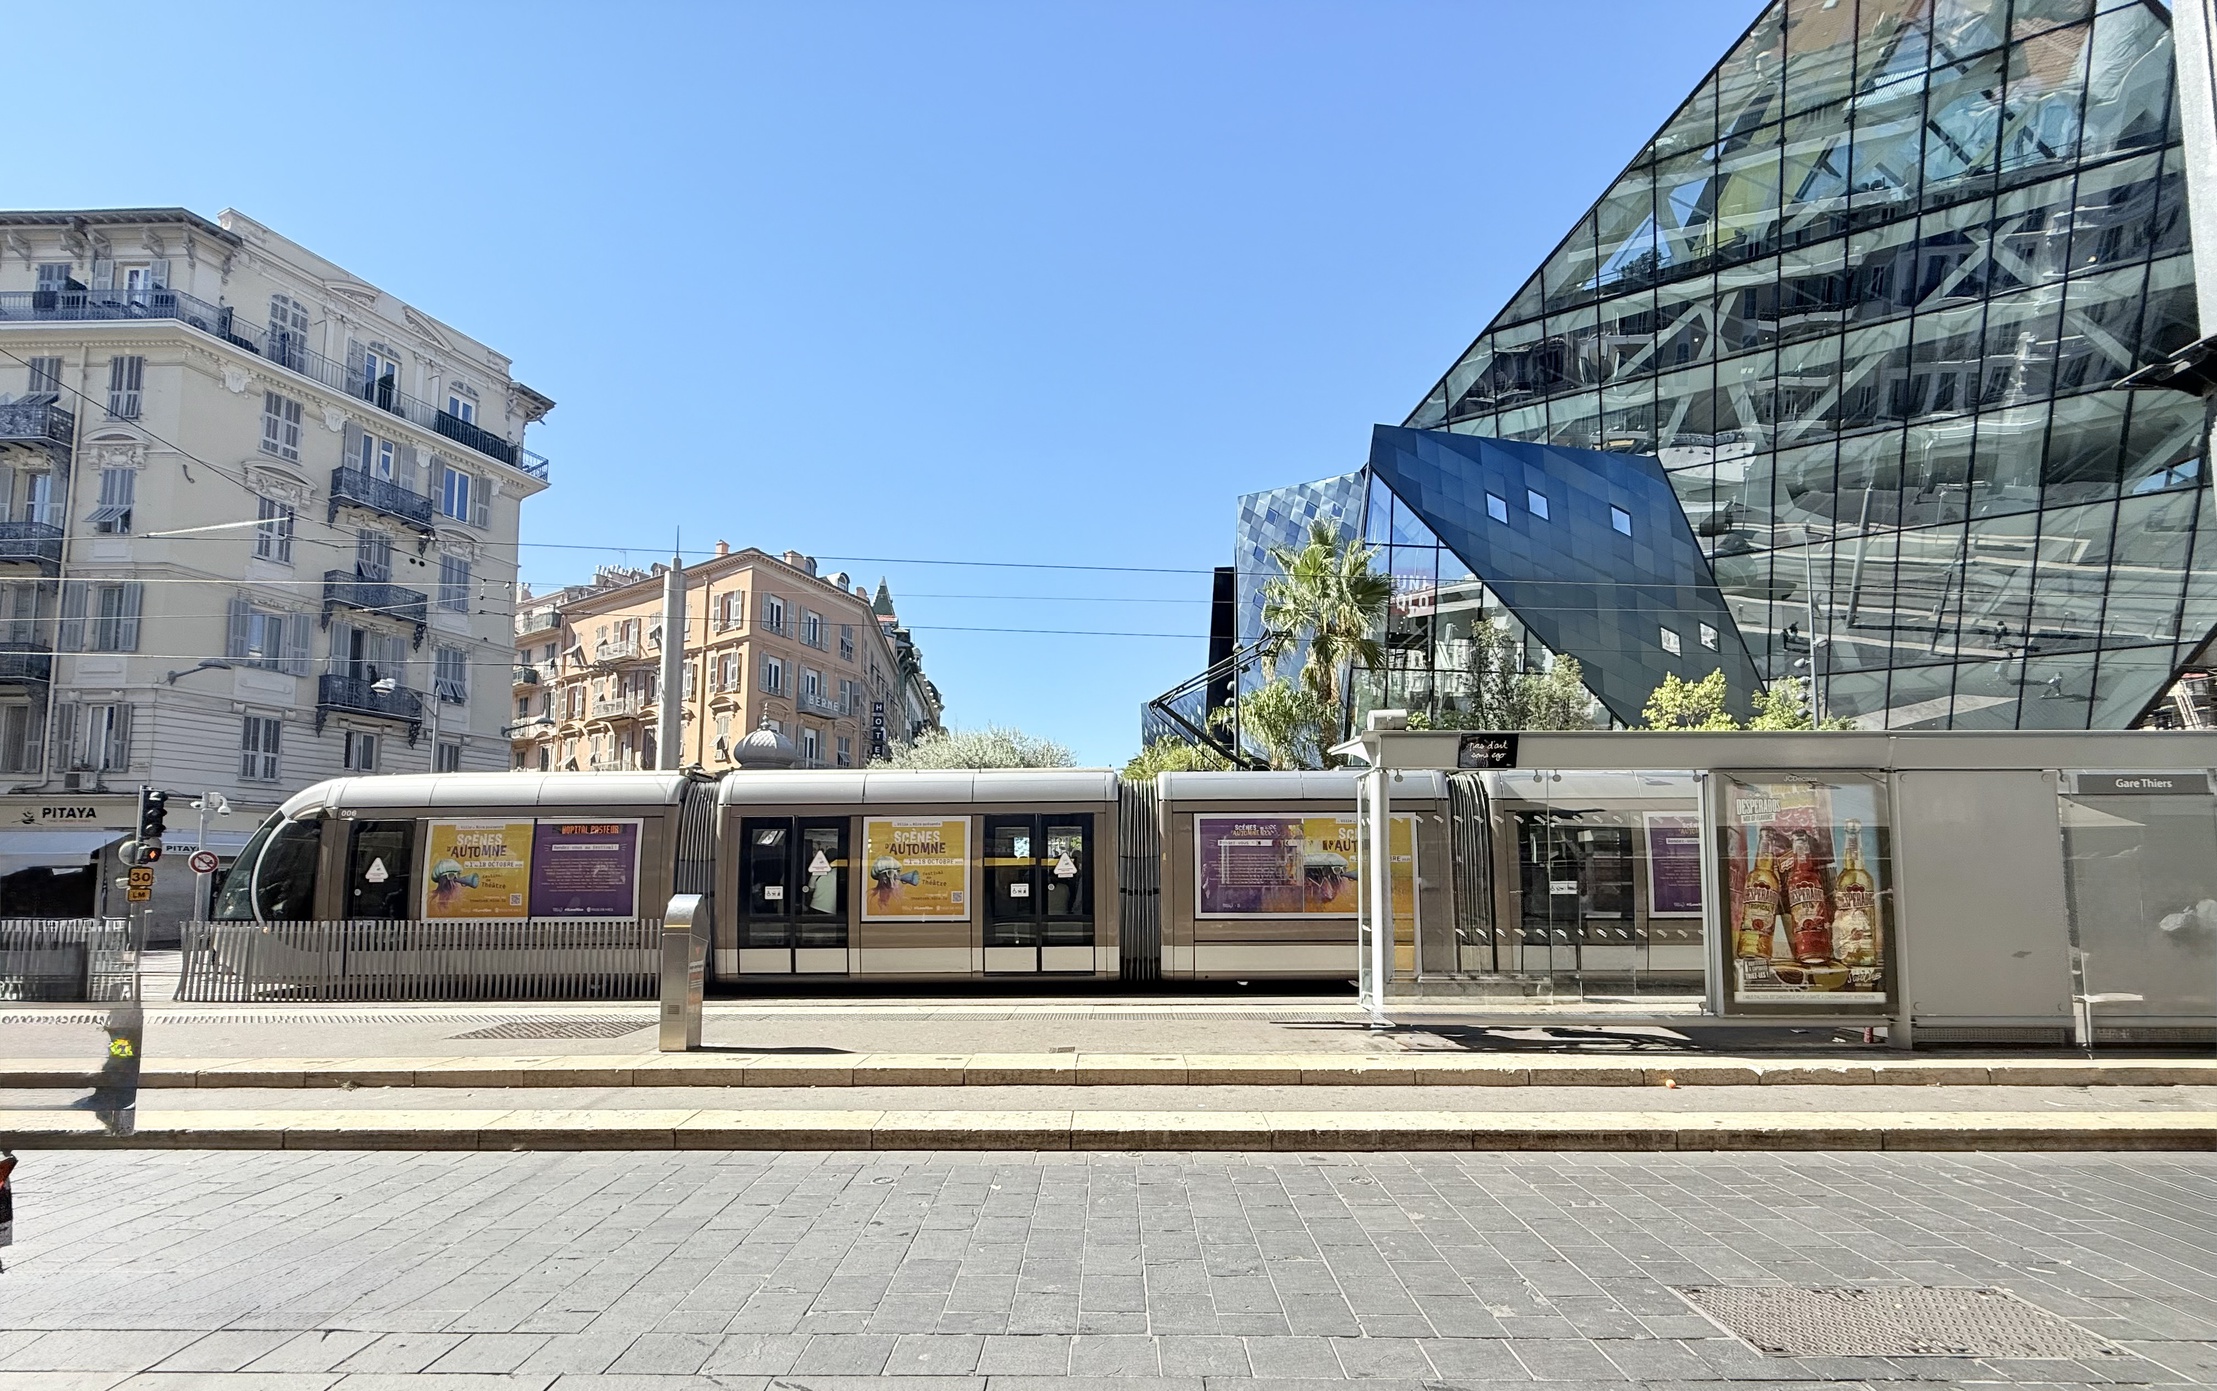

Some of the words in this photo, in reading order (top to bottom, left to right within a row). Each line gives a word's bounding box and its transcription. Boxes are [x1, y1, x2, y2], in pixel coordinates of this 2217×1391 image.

[809, 695, 839, 711] BERNE
[875, 704, 883, 753] HOTE
[1491, 752, 1506, 761] ego
[2115, 778, 2140, 788] Gare
[2140, 778, 2173, 788] Thiers
[42, 807, 96, 818] PITAYA
[1736, 798, 1780, 814] DESPERADOS
[447, 845, 507, 858] D'AUTOMNE
[885, 842, 946, 856] D'AUTOMNE
[132, 872, 150, 882] 30
